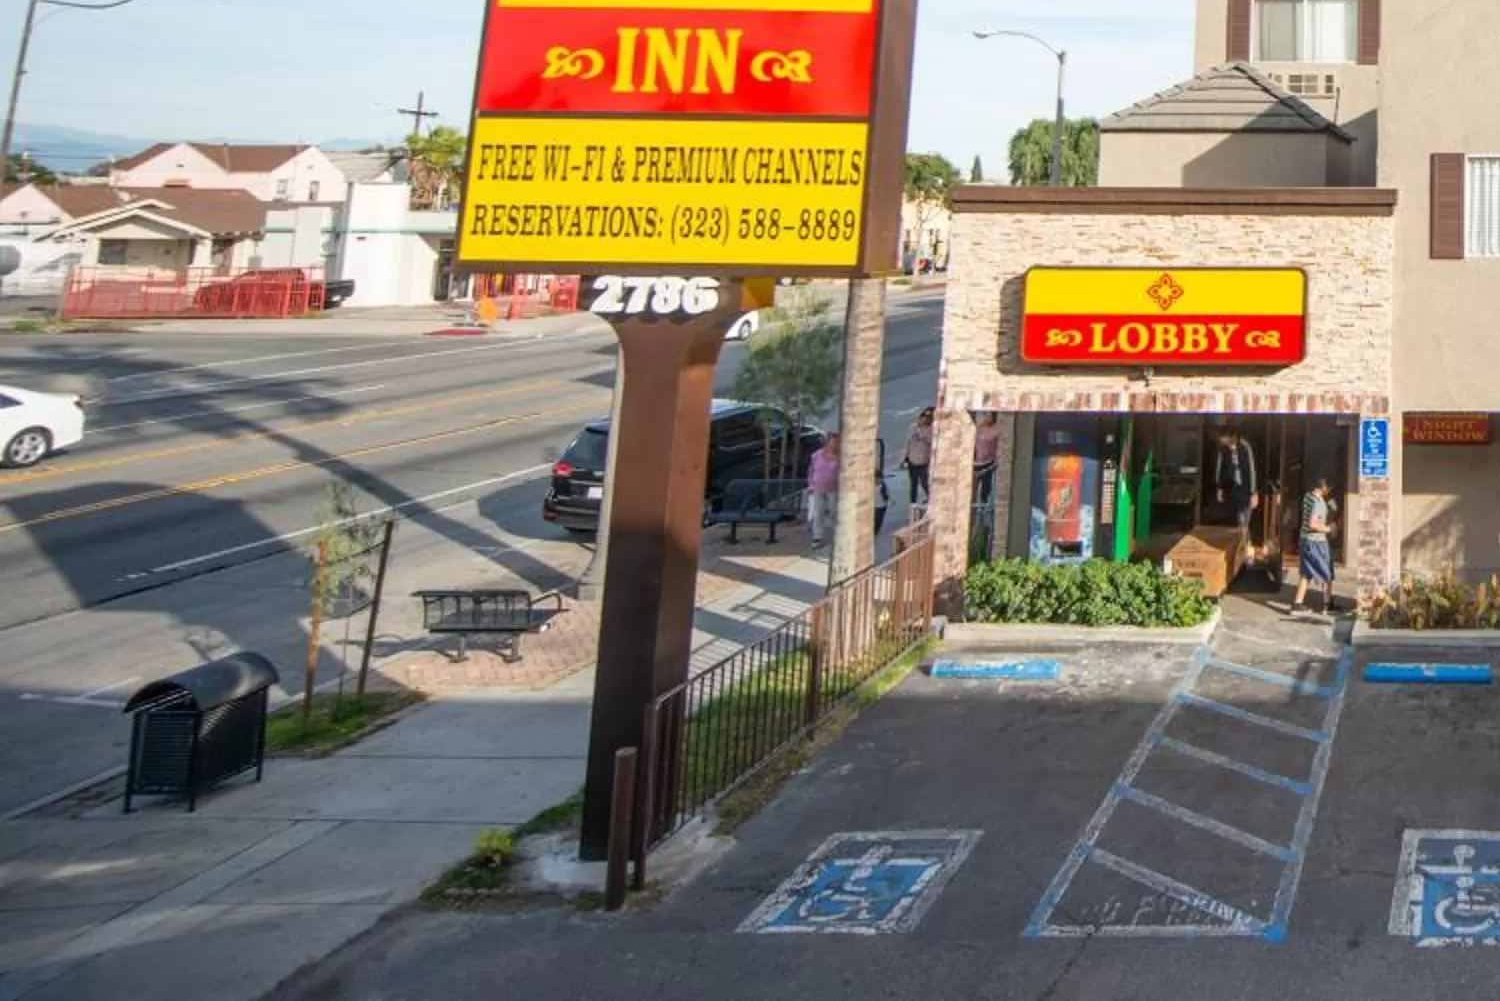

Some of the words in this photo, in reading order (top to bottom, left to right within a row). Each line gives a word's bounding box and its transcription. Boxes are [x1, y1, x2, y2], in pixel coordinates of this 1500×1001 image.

[611, 27, 744, 94] INN
[477, 144, 537, 181] FREE
[543, 144, 606, 182] WI-FI
[611, 145, 625, 182] &
[632, 146, 739, 184] PREMIUM
[743, 147, 862, 186] CHANNELS
[470, 203, 663, 238] RESERVATIONS:
[671, 204, 730, 246] (323)
[739, 207, 856, 241] 588-8889
[589, 274, 720, 314] 2786
[1088, 322, 1240, 353] LOBBY
[1412, 430, 1486, 440] WINDOW
